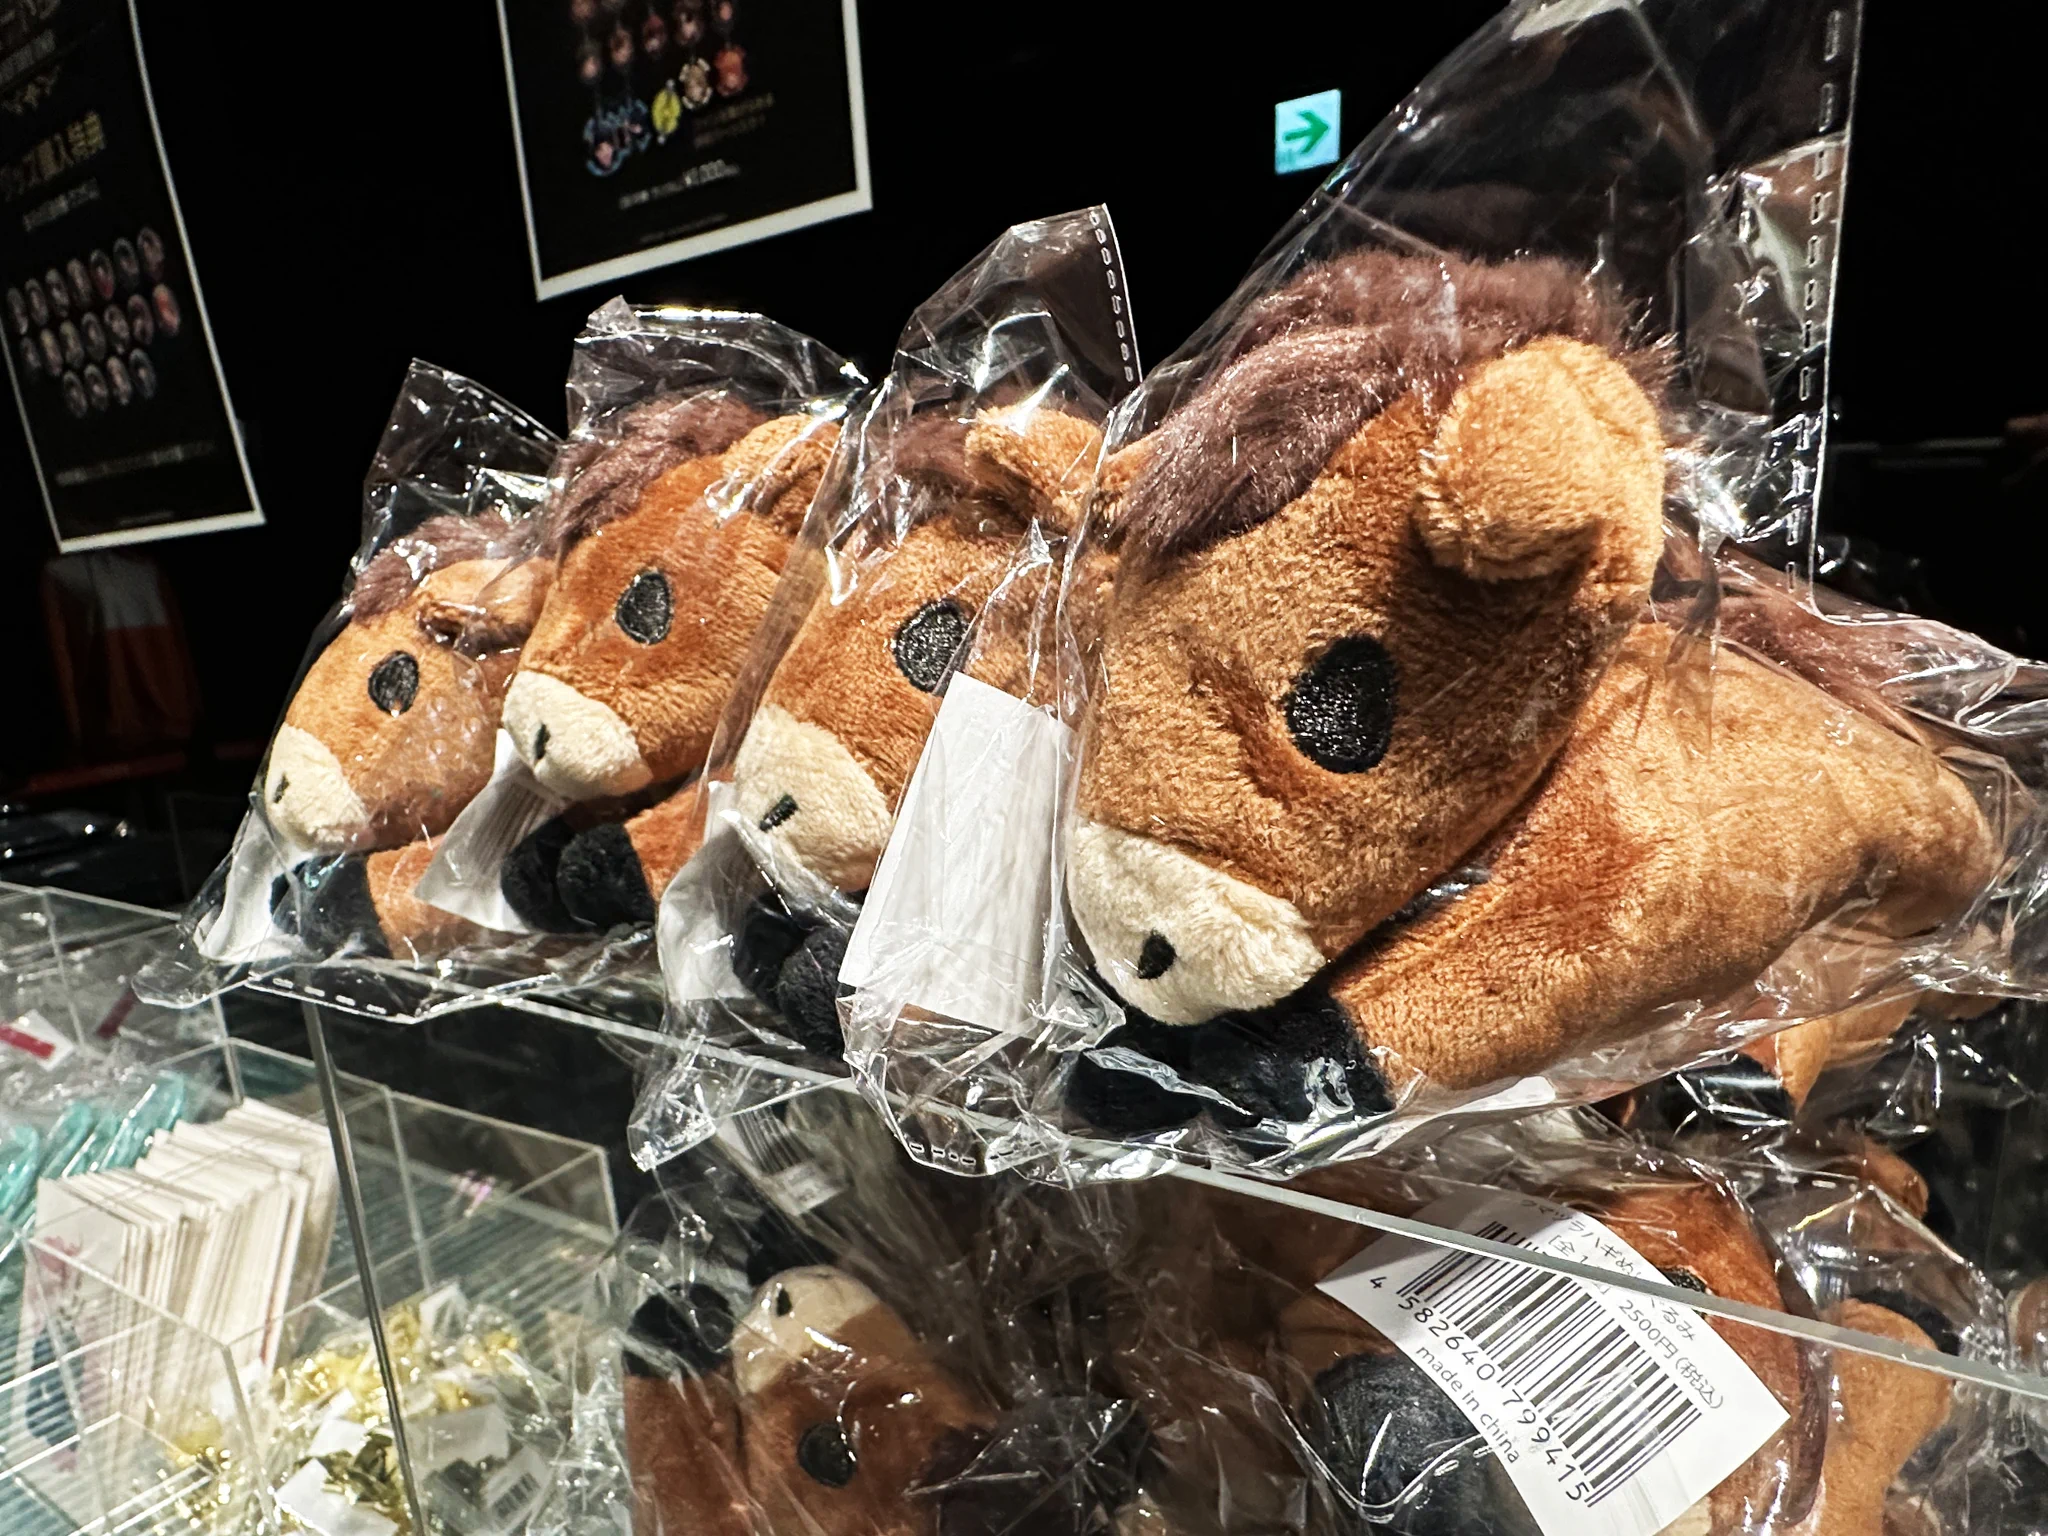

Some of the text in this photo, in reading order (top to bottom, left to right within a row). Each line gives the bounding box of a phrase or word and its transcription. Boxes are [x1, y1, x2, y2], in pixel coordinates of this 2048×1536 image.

[1369, 1275, 1590, 1501] 4 582640 799415
[1416, 1346, 1520, 1464] made in china
